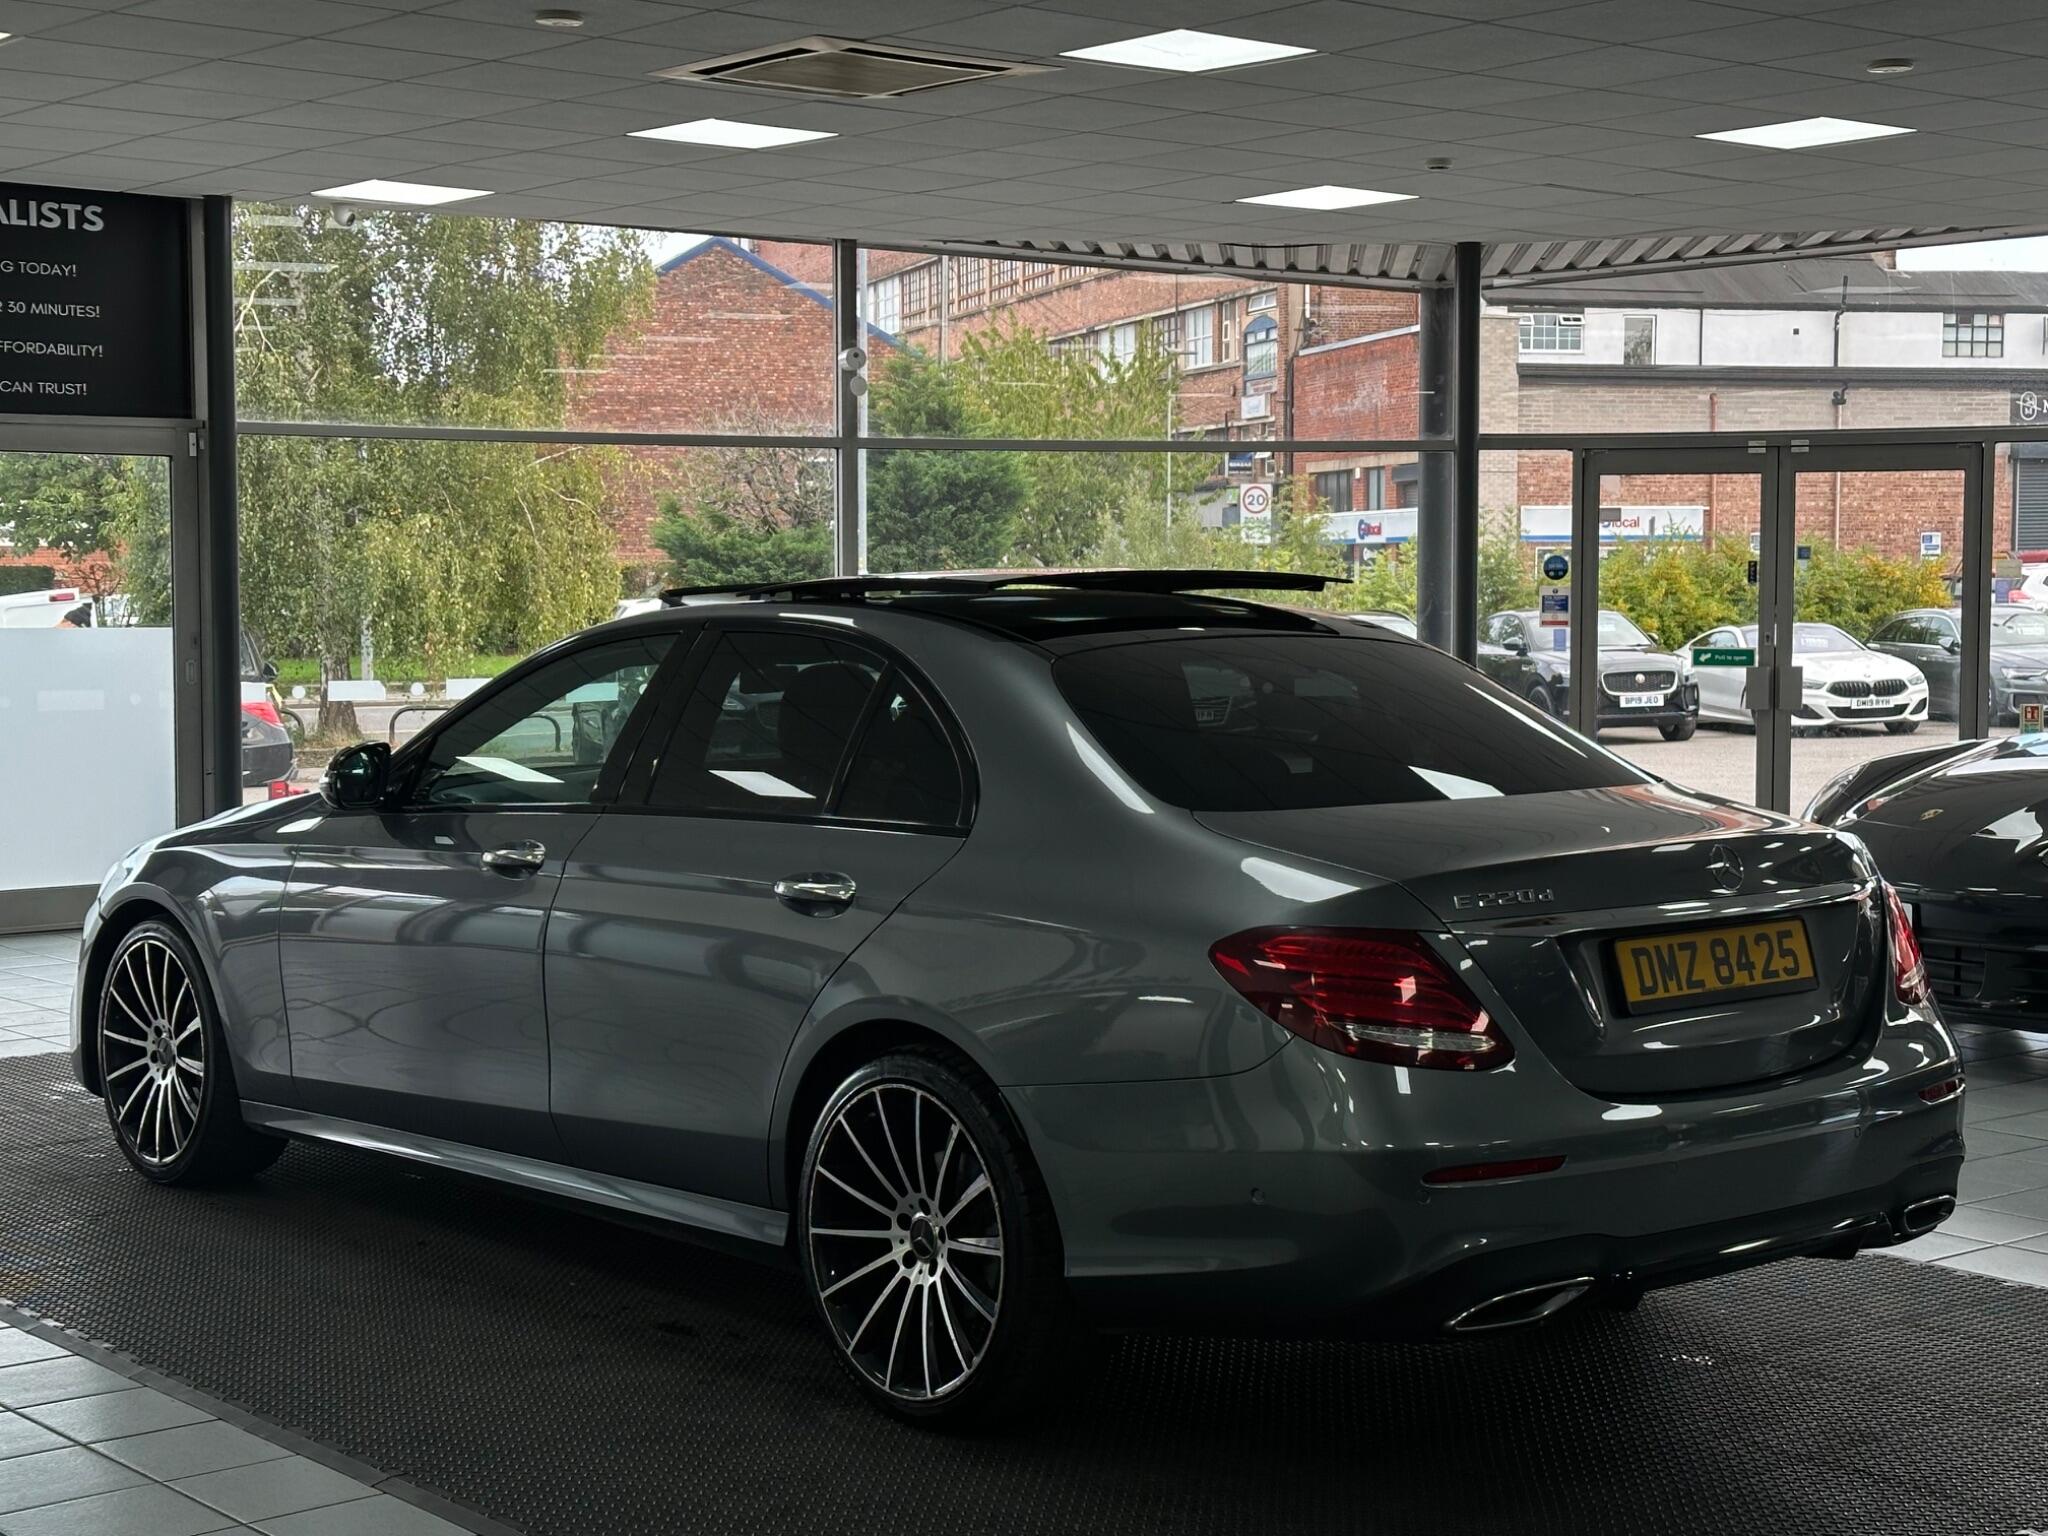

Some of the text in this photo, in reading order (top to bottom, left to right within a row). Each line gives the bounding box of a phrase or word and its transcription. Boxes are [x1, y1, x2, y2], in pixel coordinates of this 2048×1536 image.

[19, 262, 76, 277] TODAY!
[7, 301, 26, 314] 30
[30, 303, 100, 318] MINUTES!
[0, 381, 87, 396] CAN TRUST!
[1247, 494, 1265, 506] 20
[1631, 929, 1800, 996] DMZ 8425
